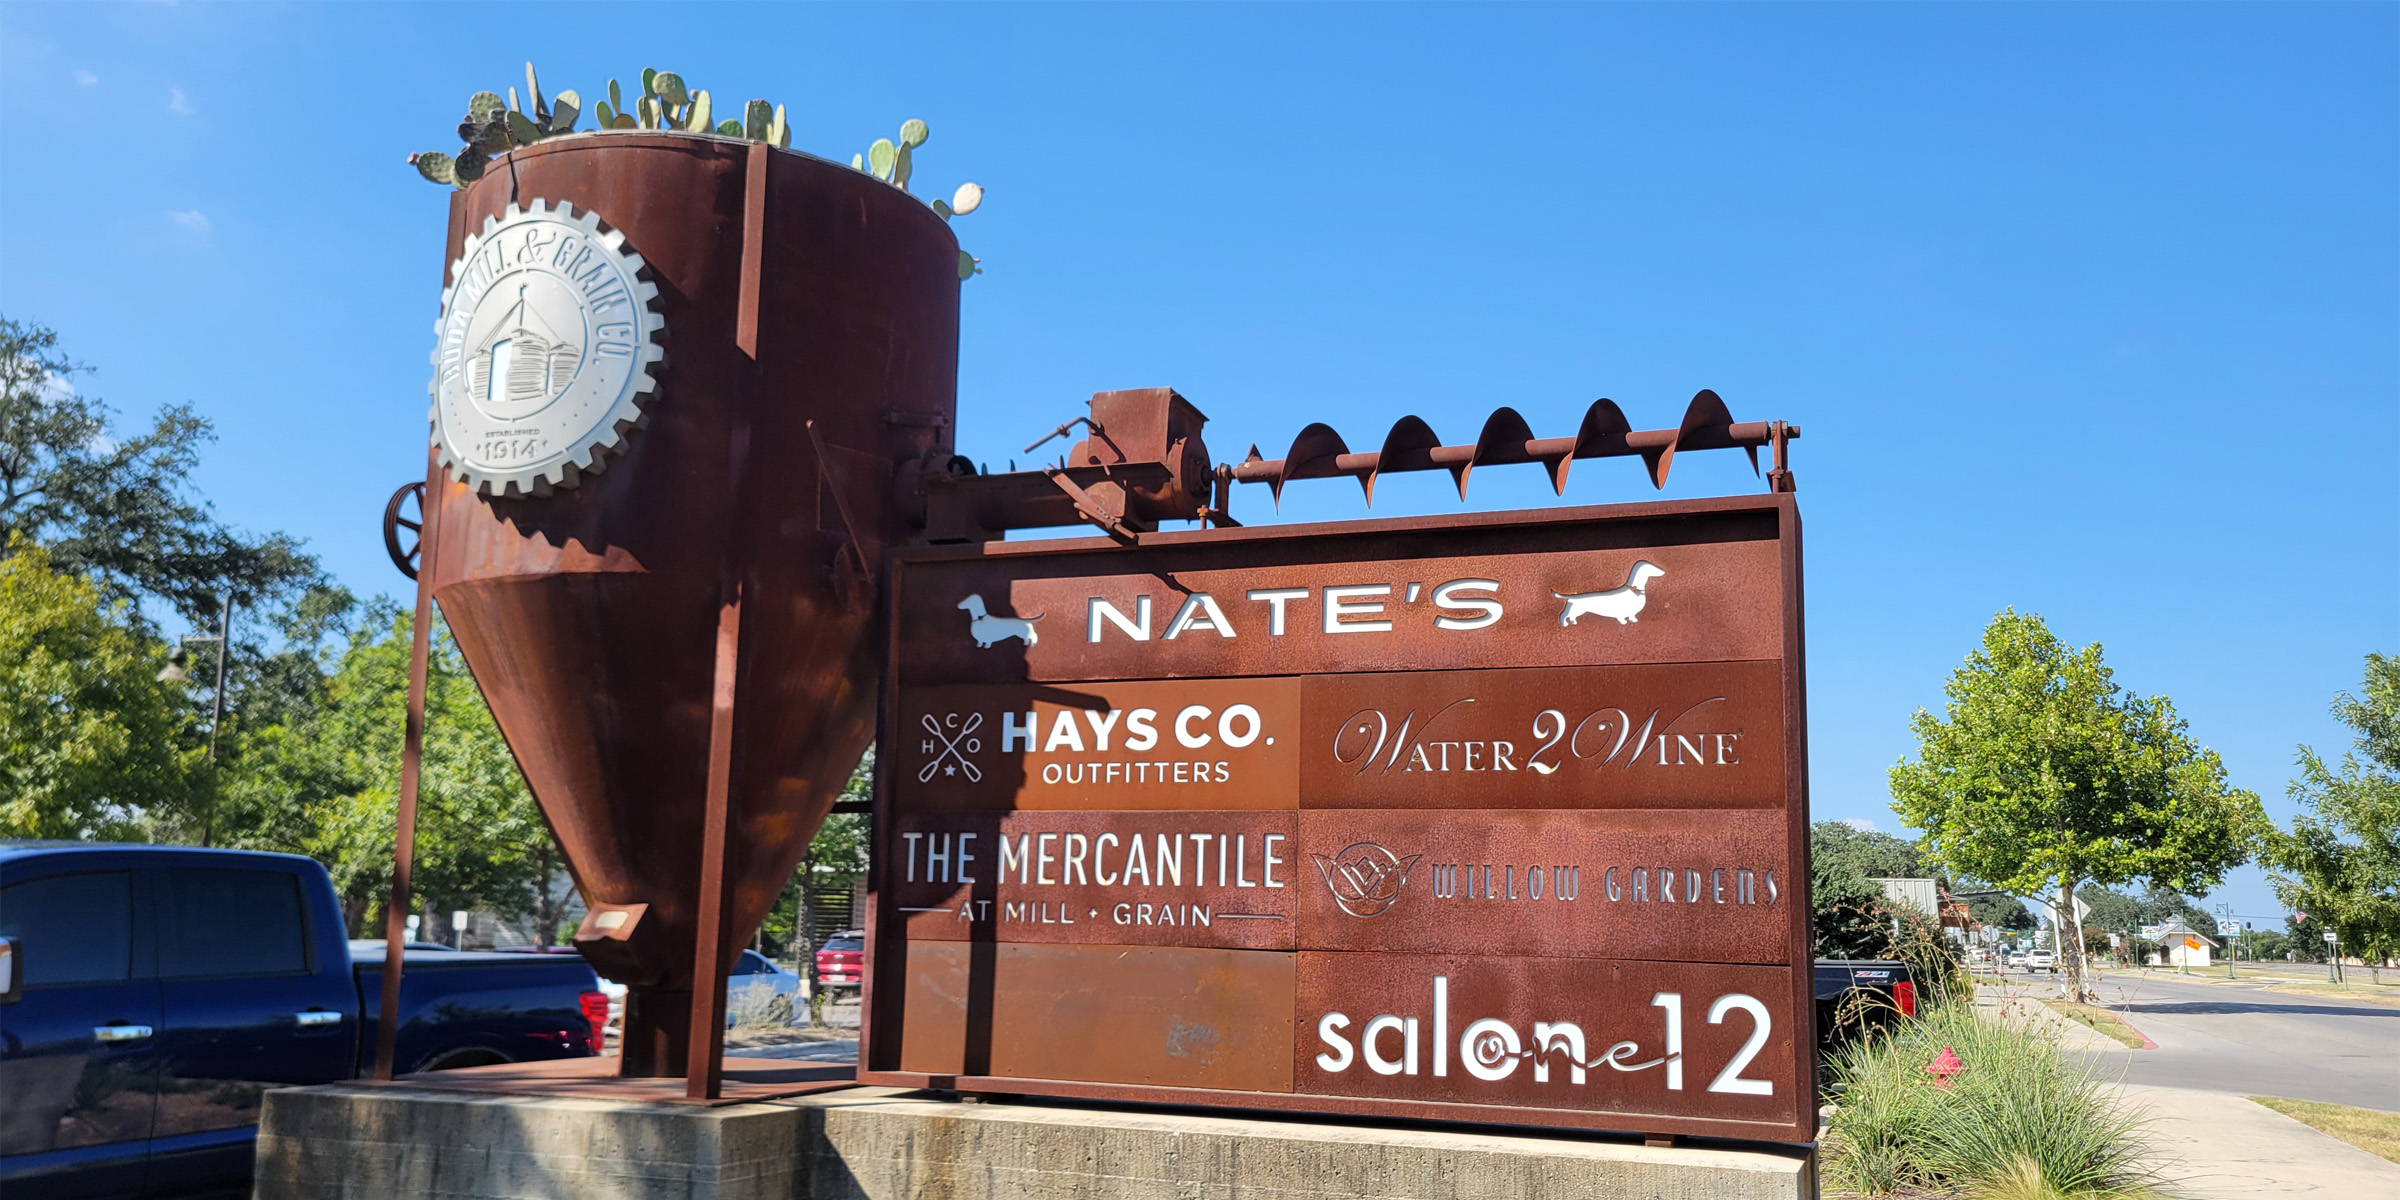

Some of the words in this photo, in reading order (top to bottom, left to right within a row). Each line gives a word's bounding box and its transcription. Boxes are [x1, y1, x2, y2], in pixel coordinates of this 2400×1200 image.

[442, 307, 472, 386] BUDA
[464, 241, 511, 300] MILL
[517, 228, 557, 264] &
[552, 235, 626, 316] GRAIN
[592, 321, 634, 366] CO.
[485, 428, 541, 438] ESTABLISHED
[485, 439, 538, 461] 1914
[1087, 577, 1504, 643] NATE'S
[1001, 707, 1159, 753] HAYS
[1173, 702, 1276, 750] CO.
[1334, 698, 1518, 777] WATER
[1525, 708, 1567, 776] 2
[1041, 760, 1231, 784] OUTFITTERS
[902, 831, 978, 884] THE
[997, 832, 1286, 888] MERCANTILE
[1432, 863, 1580, 901] WILLOW
[1604, 866, 1778, 906] GARDENS
[955, 900, 992, 922] AT
[1004, 901, 1076, 925] MILL
[1112, 902, 1212, 928] GRAIN
[1854, 970, 1891, 978] Z71
[1650, 991, 1775, 1097] 12
